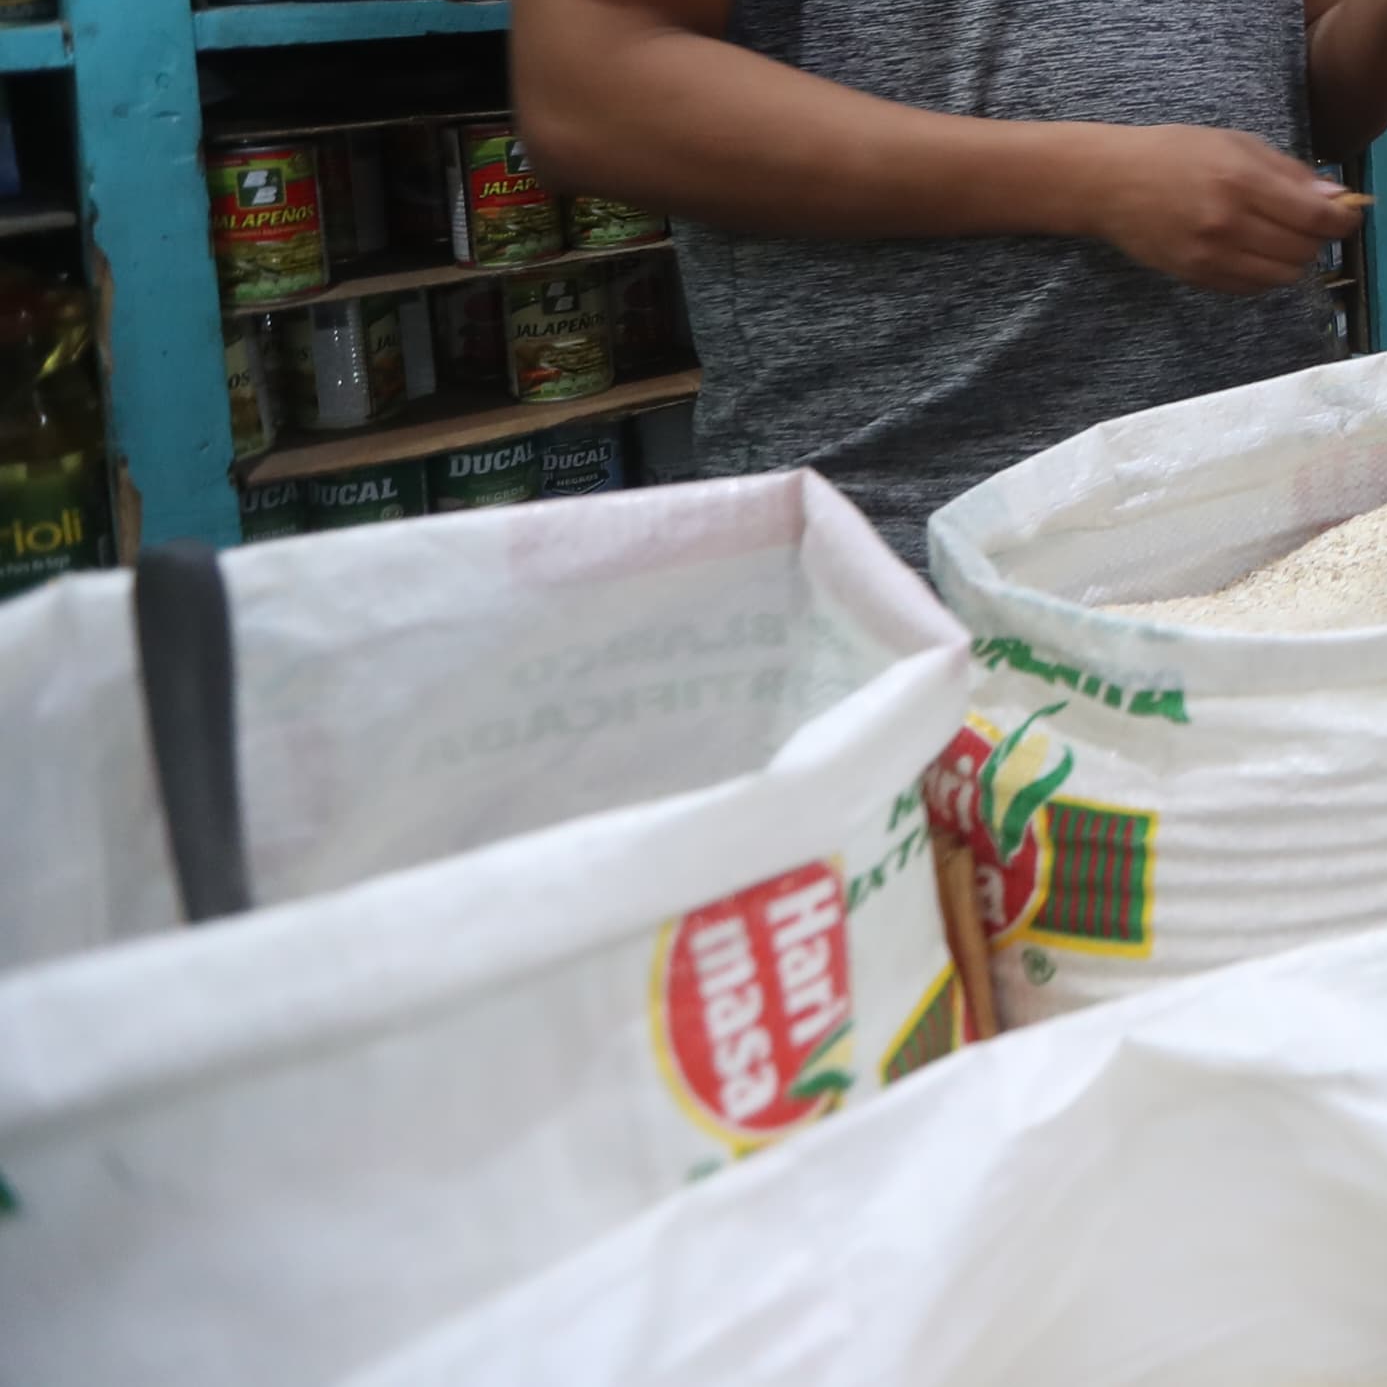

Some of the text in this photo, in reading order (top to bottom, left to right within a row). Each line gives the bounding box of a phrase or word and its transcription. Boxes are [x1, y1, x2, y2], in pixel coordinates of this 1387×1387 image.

[447, 443, 534, 477] DUCAL
[541, 445, 612, 472] DUCAL
[764, 876, 851, 1048] Hari
[689, 914, 779, 1123] masa
